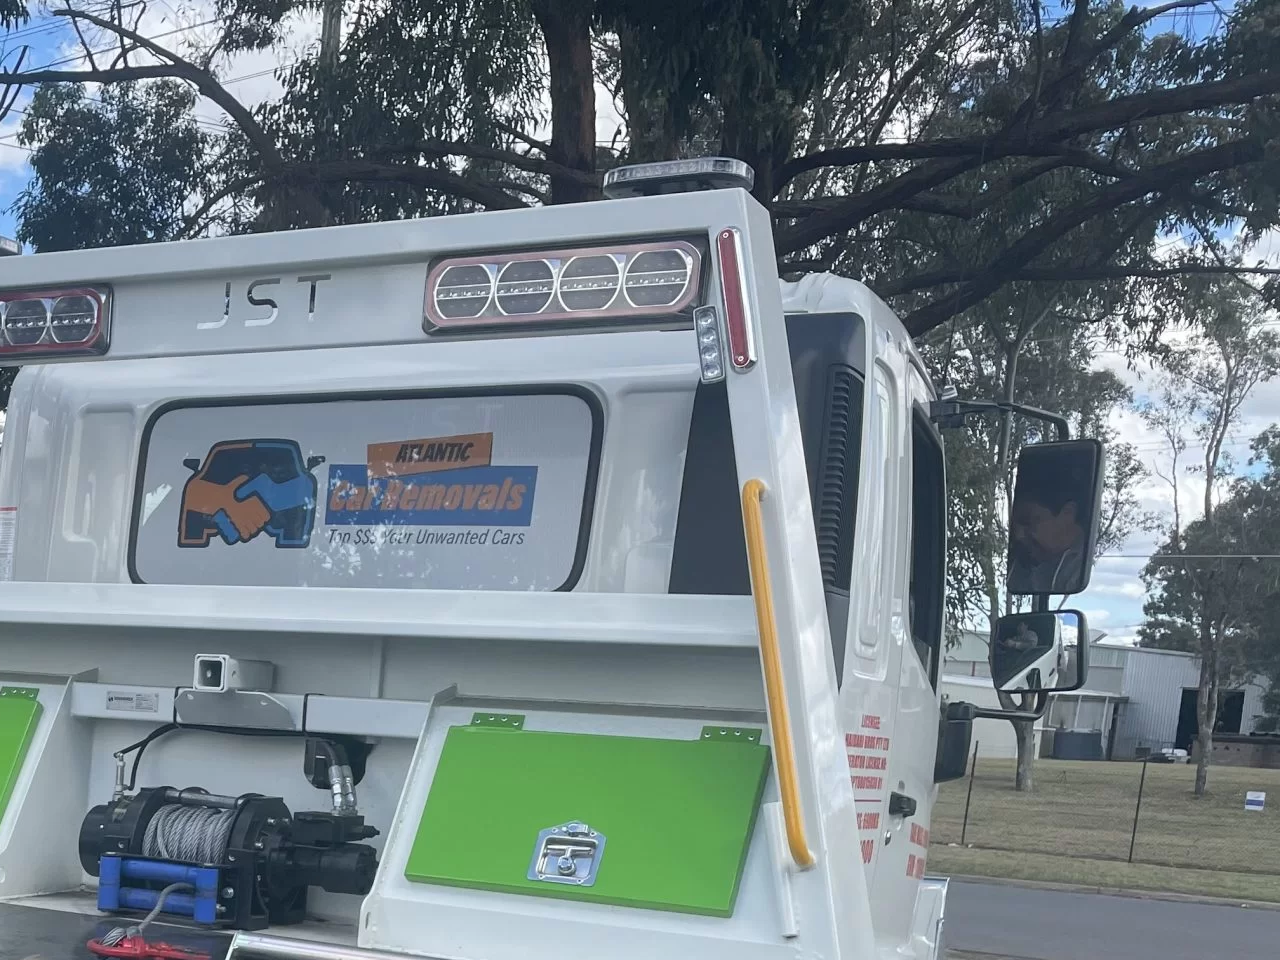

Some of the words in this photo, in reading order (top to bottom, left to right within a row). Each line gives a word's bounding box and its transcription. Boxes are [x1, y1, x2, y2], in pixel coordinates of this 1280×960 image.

[197, 274, 331, 329] JST
[395, 442, 474, 463] ATLANTIC
[330, 479, 380, 511] Car
[380, 477, 527, 512] Removals
[416, 529, 489, 545] Unwanted
[491, 529, 525, 545] Cars
